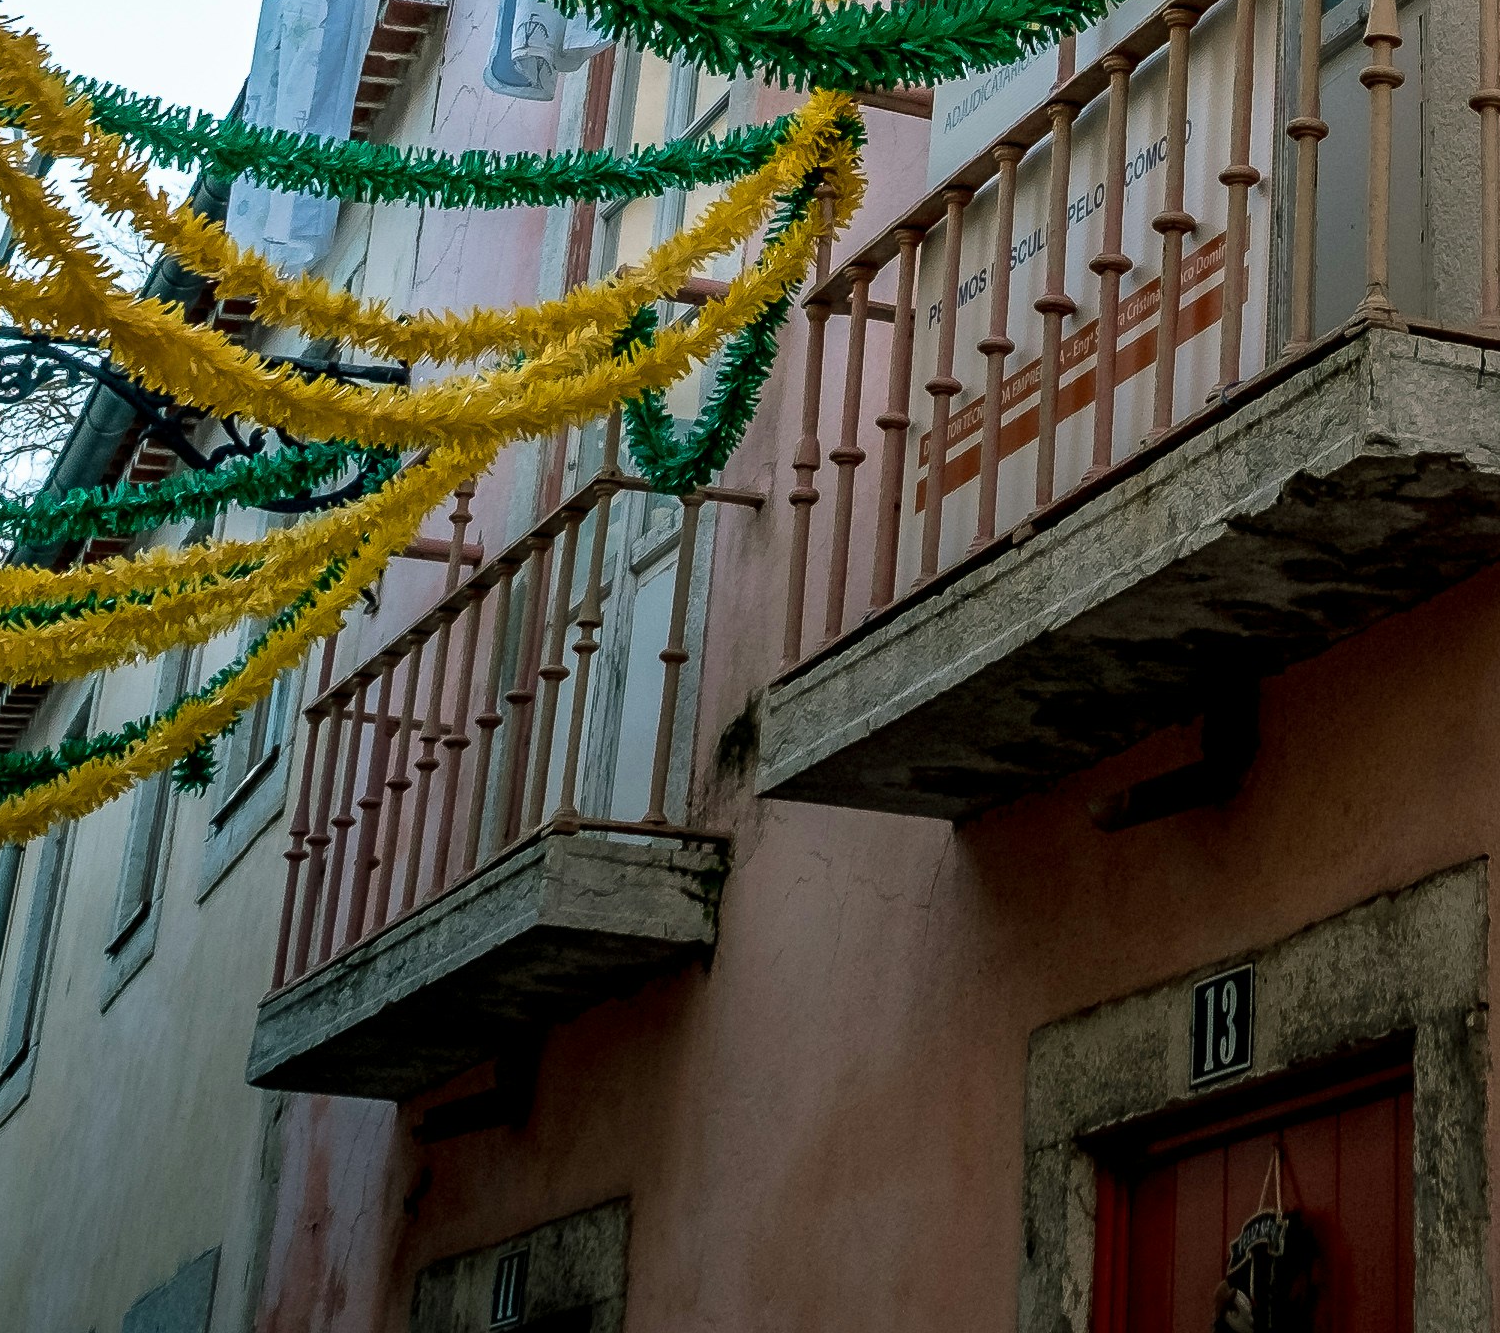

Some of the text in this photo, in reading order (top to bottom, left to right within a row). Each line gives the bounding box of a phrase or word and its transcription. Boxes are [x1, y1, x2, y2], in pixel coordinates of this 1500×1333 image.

[928, 267, 987, 331] PEMOS
[1067, 182, 1105, 230] PELO
[1127, 288, 1161, 321] Cristina
[1204, 980, 1238, 1072] 13
[497, 1257, 518, 1320] 11
